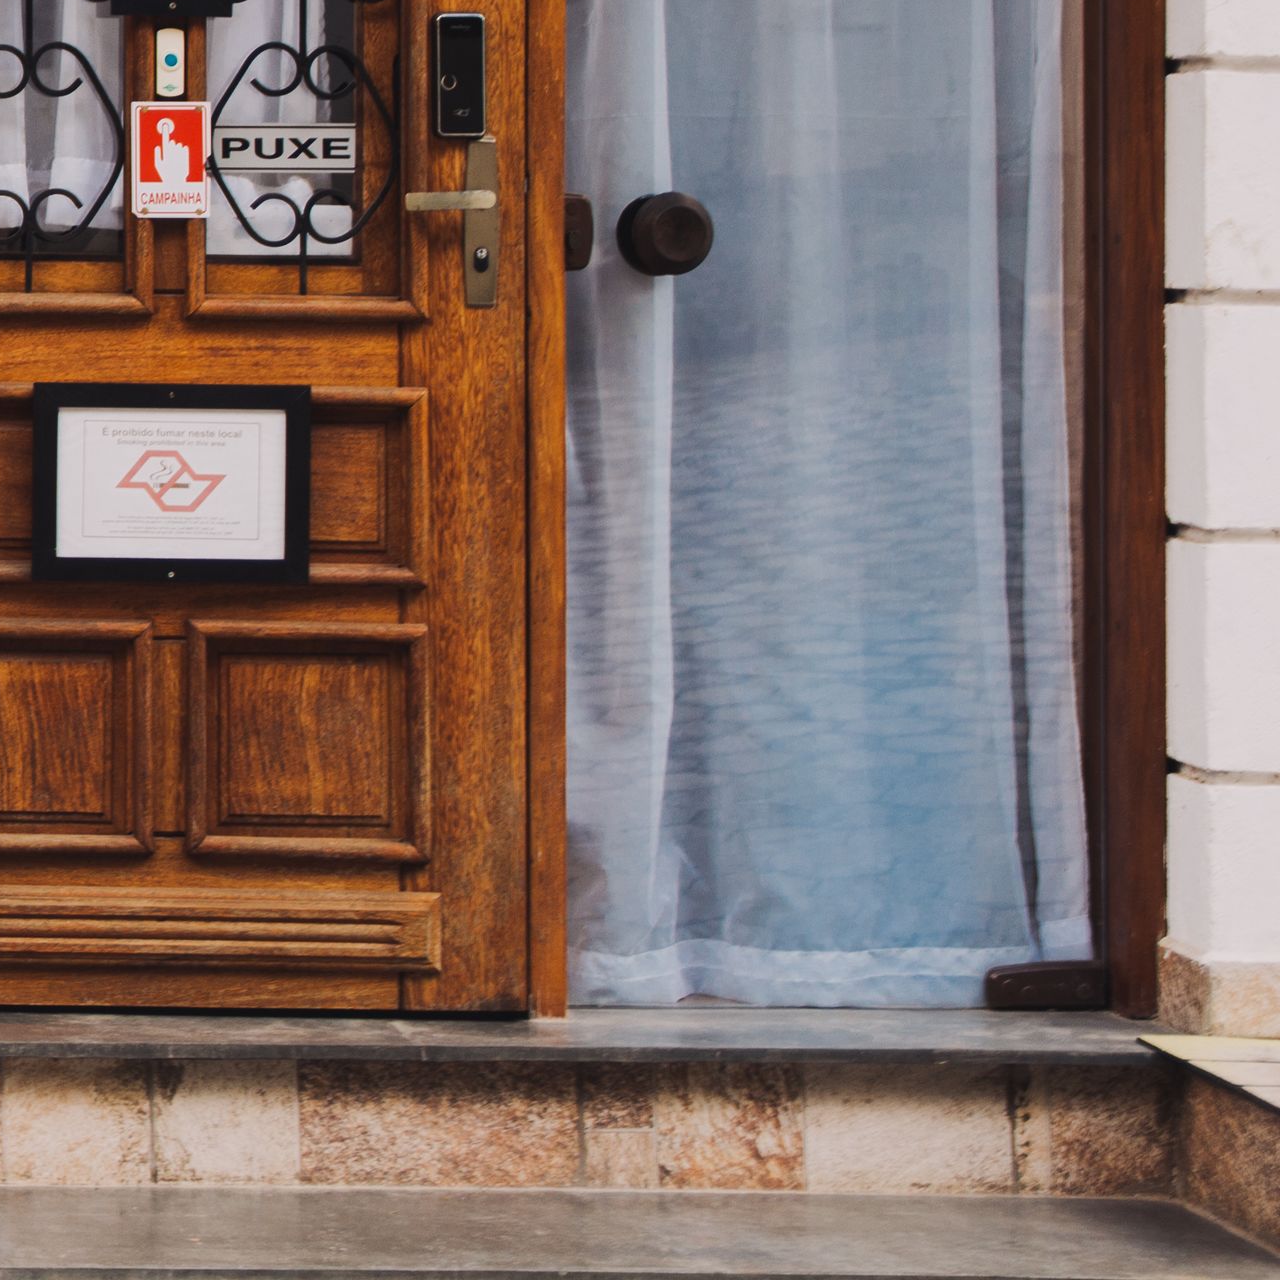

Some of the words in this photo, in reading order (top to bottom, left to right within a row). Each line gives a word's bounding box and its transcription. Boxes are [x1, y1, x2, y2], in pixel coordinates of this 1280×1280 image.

[222, 137, 351, 160] PUXE
[141, 191, 202, 206] CAMPAINHA
[111, 427, 154, 439] proibido
[156, 428, 185, 438] fumar
[188, 429, 215, 438] neste
[218, 429, 243, 439] local
